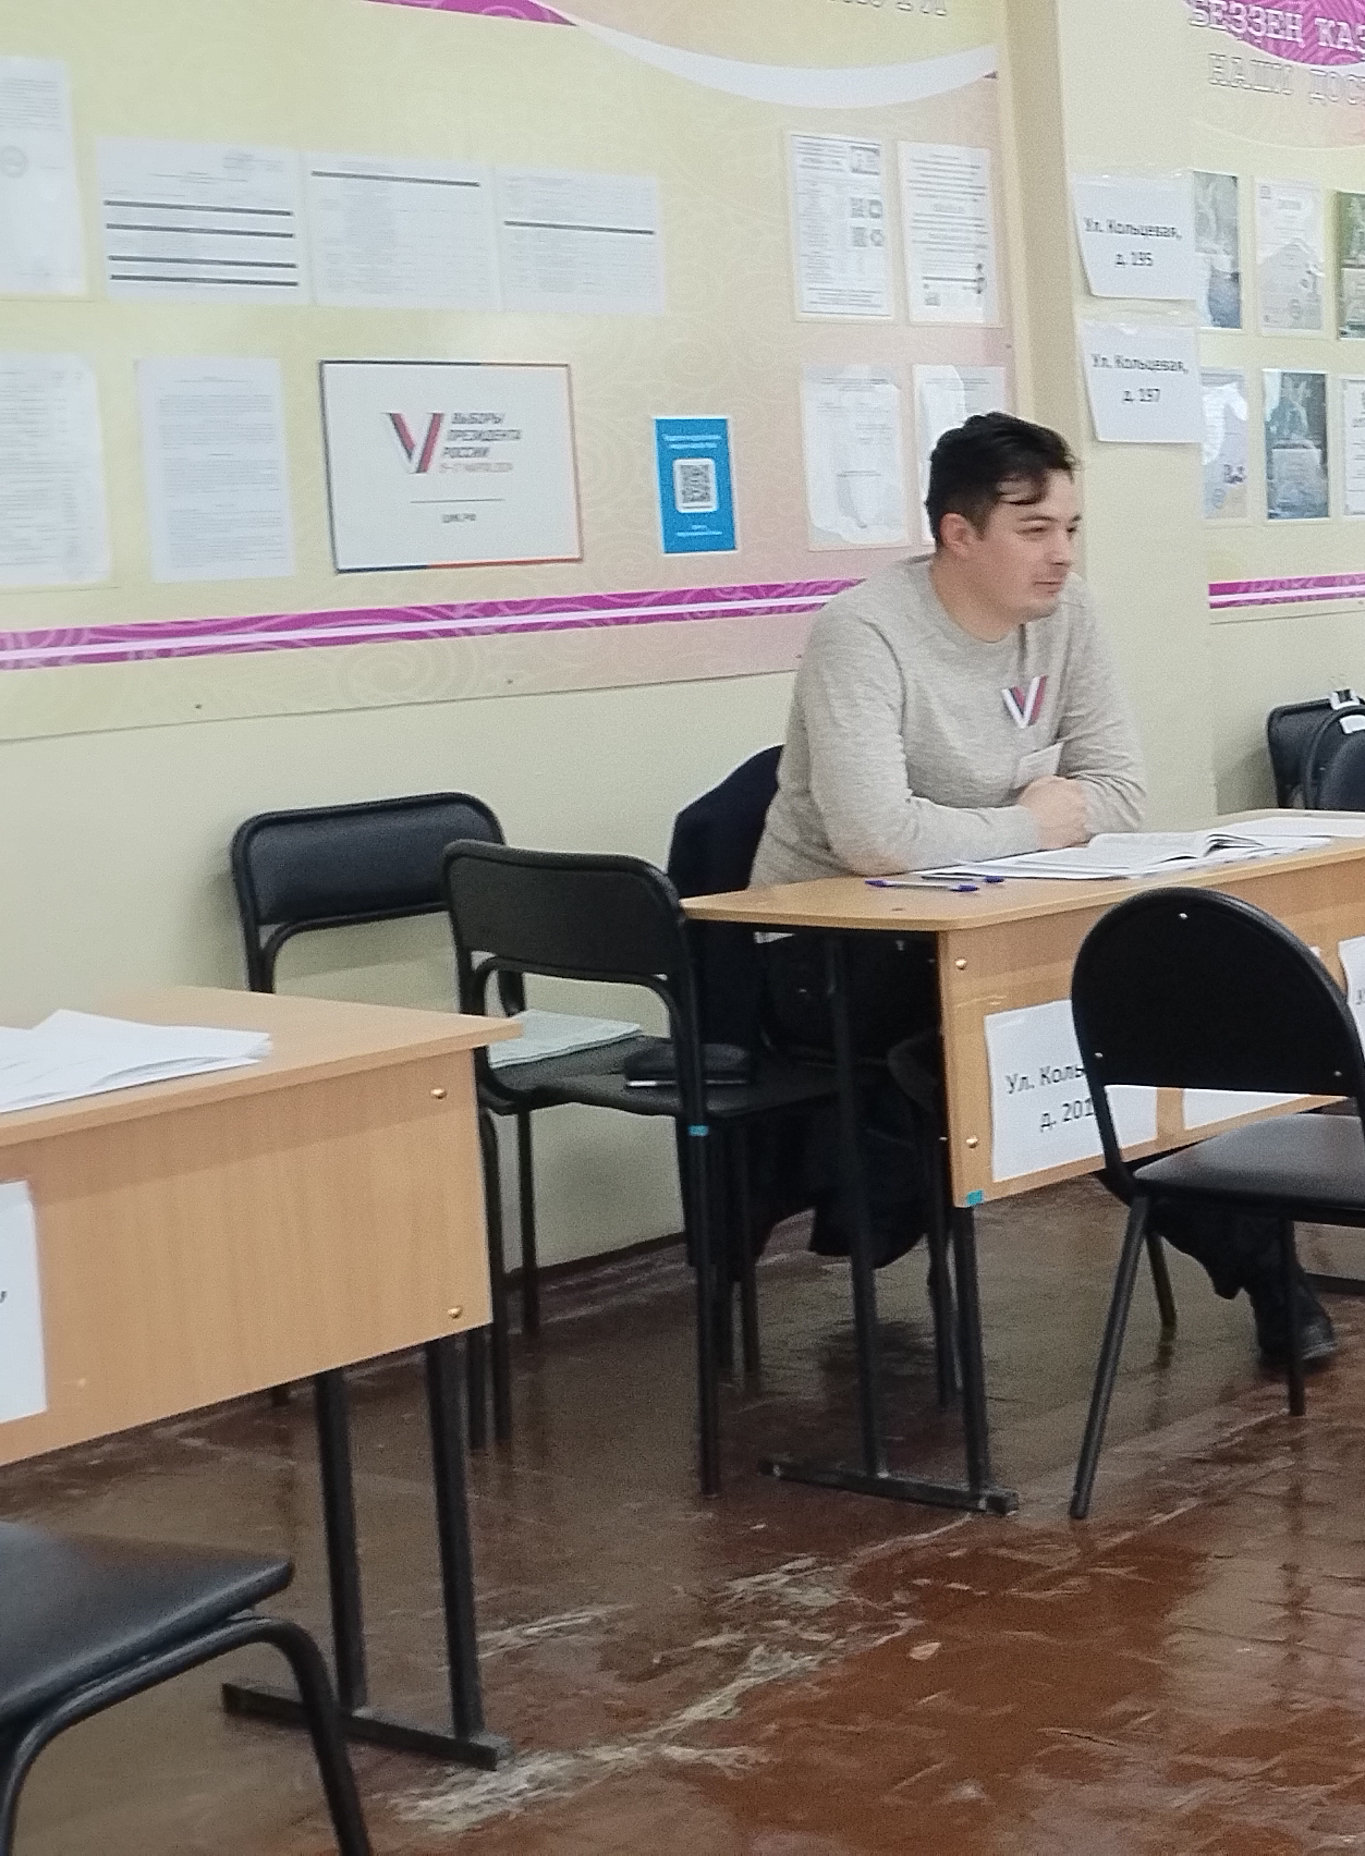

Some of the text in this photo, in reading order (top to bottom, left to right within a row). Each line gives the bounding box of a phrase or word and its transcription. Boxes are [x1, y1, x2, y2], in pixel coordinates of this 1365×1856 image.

[1106, 218, 1182, 240] Кольцевая,
[1114, 354, 1189, 374] Кольцевая,
[1005, 1073, 1035, 1094] Ул.
[1040, 1098, 1095, 1133] д. 201
